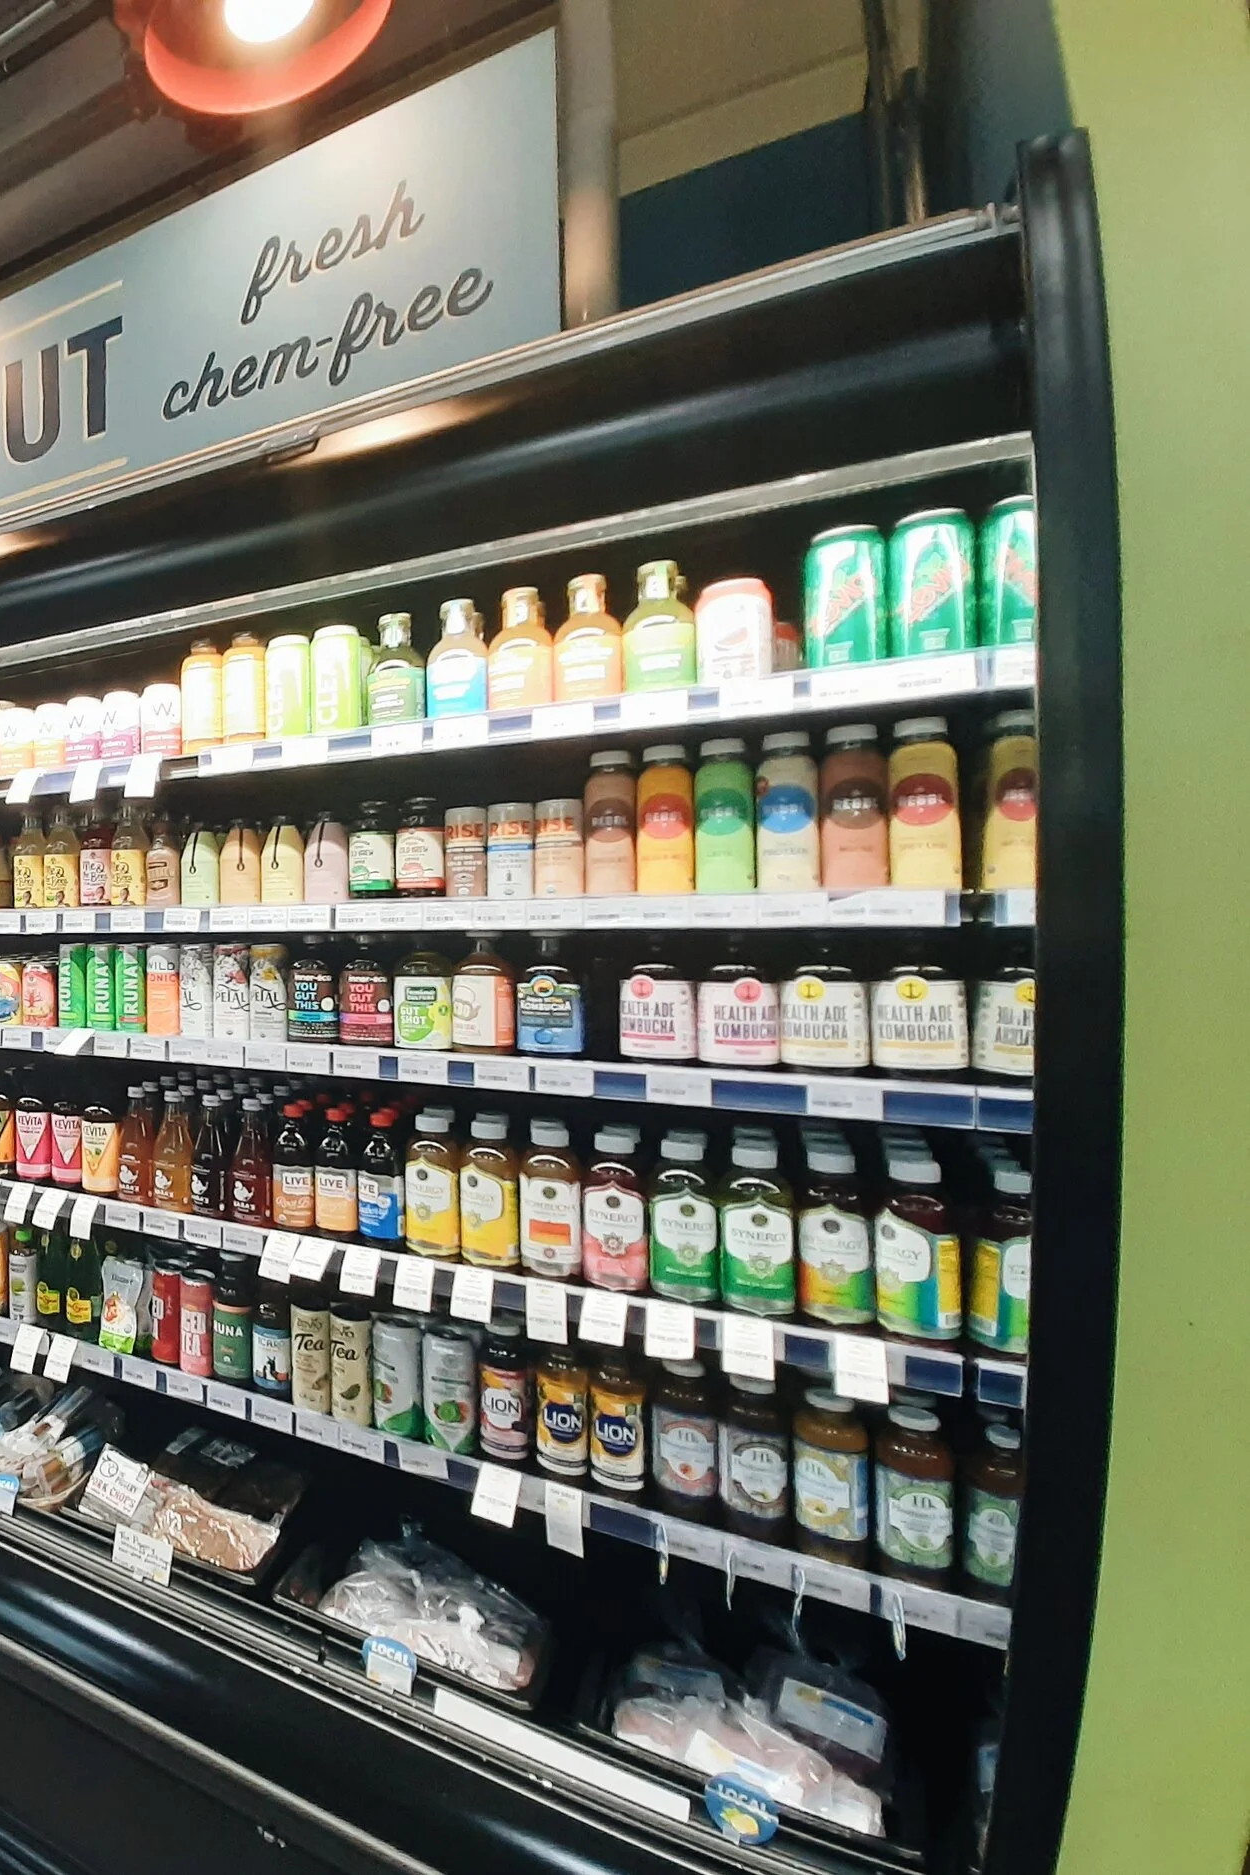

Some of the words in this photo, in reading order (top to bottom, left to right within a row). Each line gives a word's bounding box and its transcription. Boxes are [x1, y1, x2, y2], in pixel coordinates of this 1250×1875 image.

[239, 181, 424, 325] fresh
[161, 266, 493, 423] chem-free
[446, 823, 484, 839] RISE
[489, 820, 530, 836] RISE
[535, 817, 575, 833] RISE
[59, 957, 72, 1011] RUNA
[149, 973, 177, 983] ONIC
[94, 960, 109, 1014] RUNA
[124, 959, 138, 1015] RUNA
[294, 982, 318, 992] YOU
[350, 984, 375, 993] YOU
[294, 991, 317, 1001] GUT
[350, 993, 373, 1002] GUT
[294, 1001, 320, 1010] THIS
[350, 1003, 376, 1012] THIS
[400, 1006, 420, 1016] GUT
[622, 1001, 675, 1018] EALTH-ADE
[400, 1014, 427, 1026] SHOT
[621, 1017, 675, 1034] OMBUCHA
[714, 1023, 778, 1040] KOMBUCHA
[879, 1023, 955, 1041] KOMBUCHA
[285, 1176, 309, 1186] LIVE
[319, 1177, 343, 1189] LIVE
[360, 1182, 375, 1193] IVE
[589, 1208, 638, 1224] SYNERGY
[661, 1218, 715, 1232] SYNERGY
[731, 1227, 789, 1243] SYNERGY
[294, 1333, 326, 1351] Tea
[331, 1340, 359, 1361] Tea
[483, 1396, 520, 1414] LION
[543, 1410, 583, 1429] LION
[595, 1420, 636, 1441] LION
[371, 1641, 410, 1666] LOCAL
[717, 1783, 770, 1817] LOCAL
